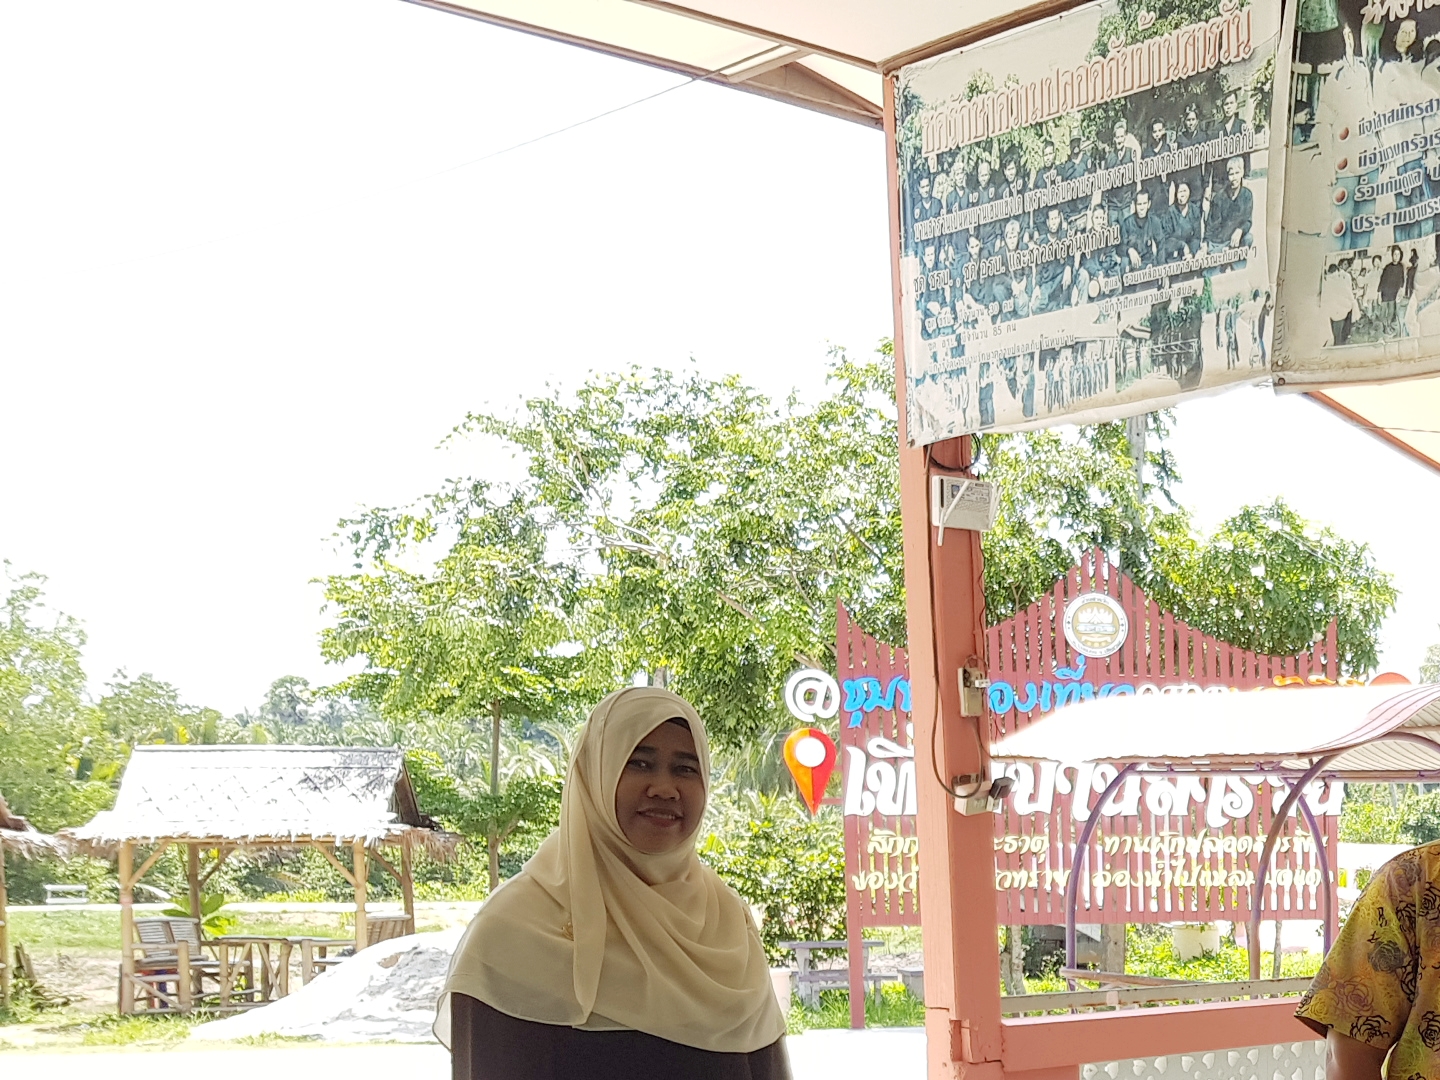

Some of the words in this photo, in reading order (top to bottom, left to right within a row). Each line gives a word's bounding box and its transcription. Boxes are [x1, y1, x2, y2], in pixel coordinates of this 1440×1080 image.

[989, 303, 999, 315] 30
[993, 326, 1002, 336] 85
[1007, 323, 1017, 333] คน
